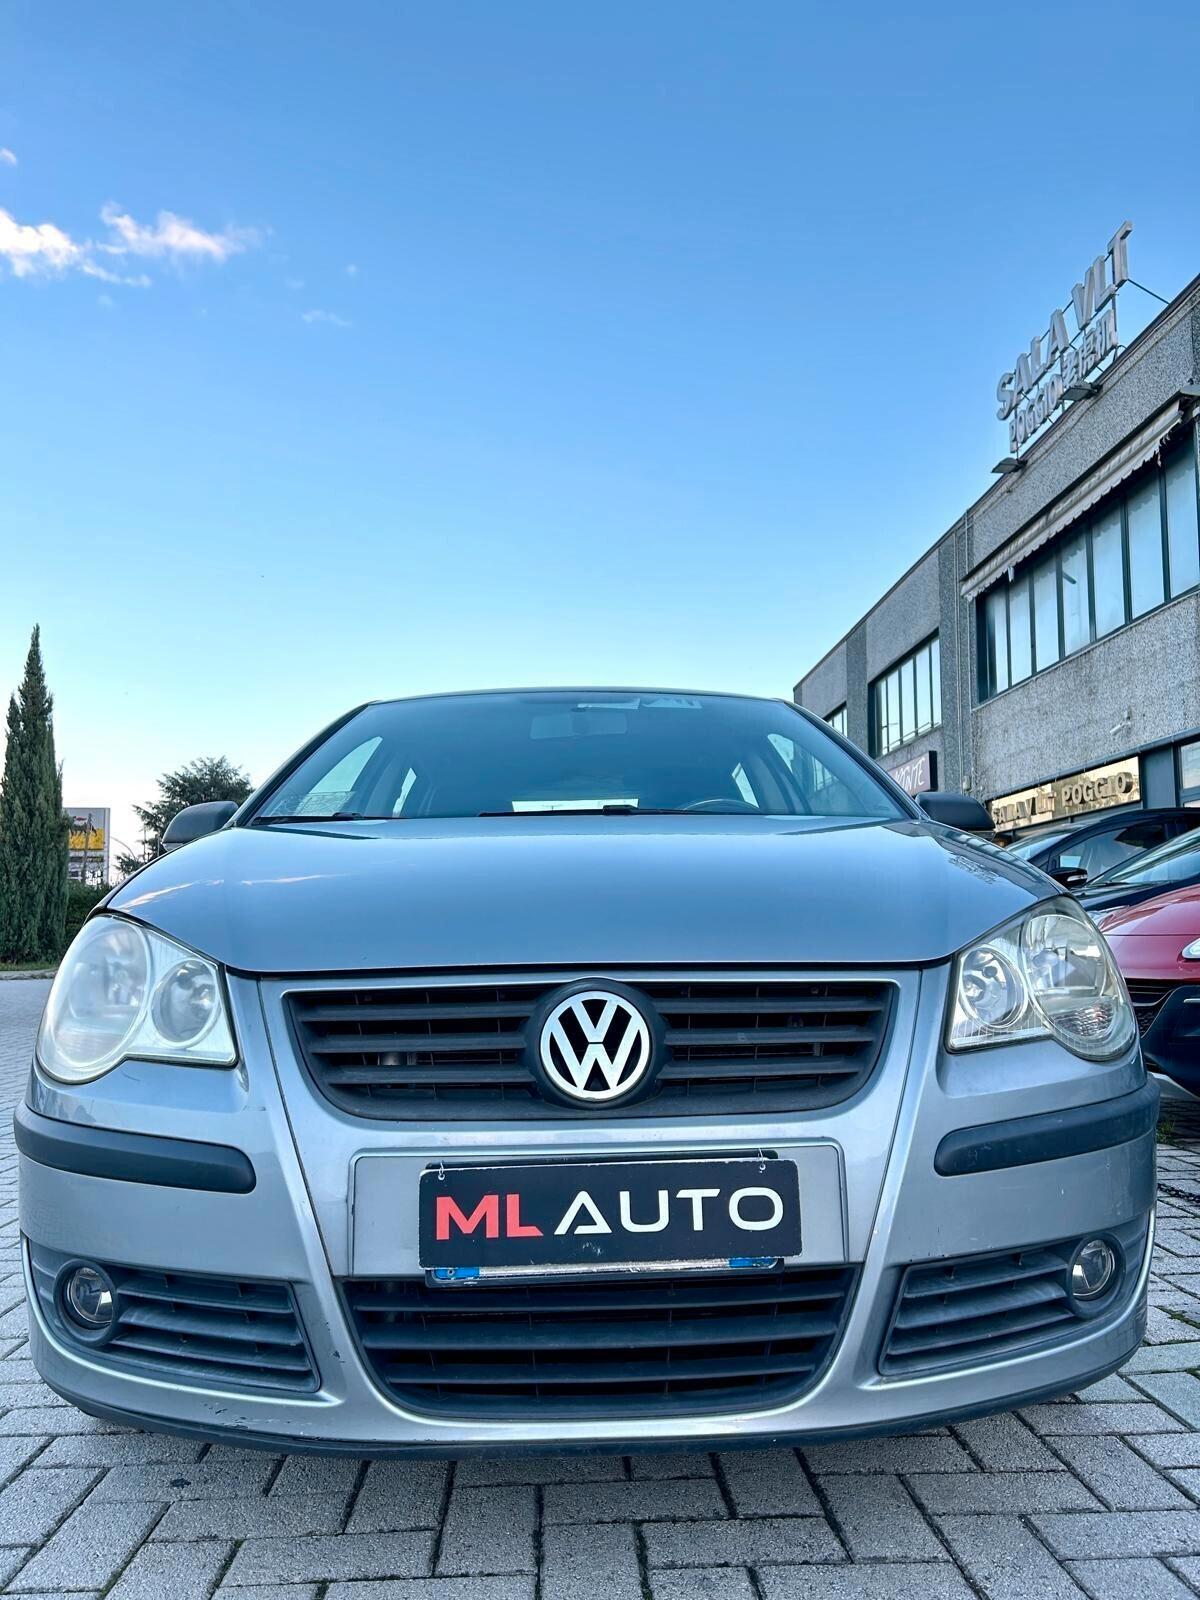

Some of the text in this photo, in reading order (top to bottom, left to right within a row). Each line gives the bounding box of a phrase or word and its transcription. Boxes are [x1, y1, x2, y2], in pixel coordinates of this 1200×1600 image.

[996, 220, 1133, 421] SALA VLT
[1009, 374, 1064, 454] POGGIO
[1061, 772, 1133, 807] POGGIO
[435, 1186, 784, 1241] ML AUTO
